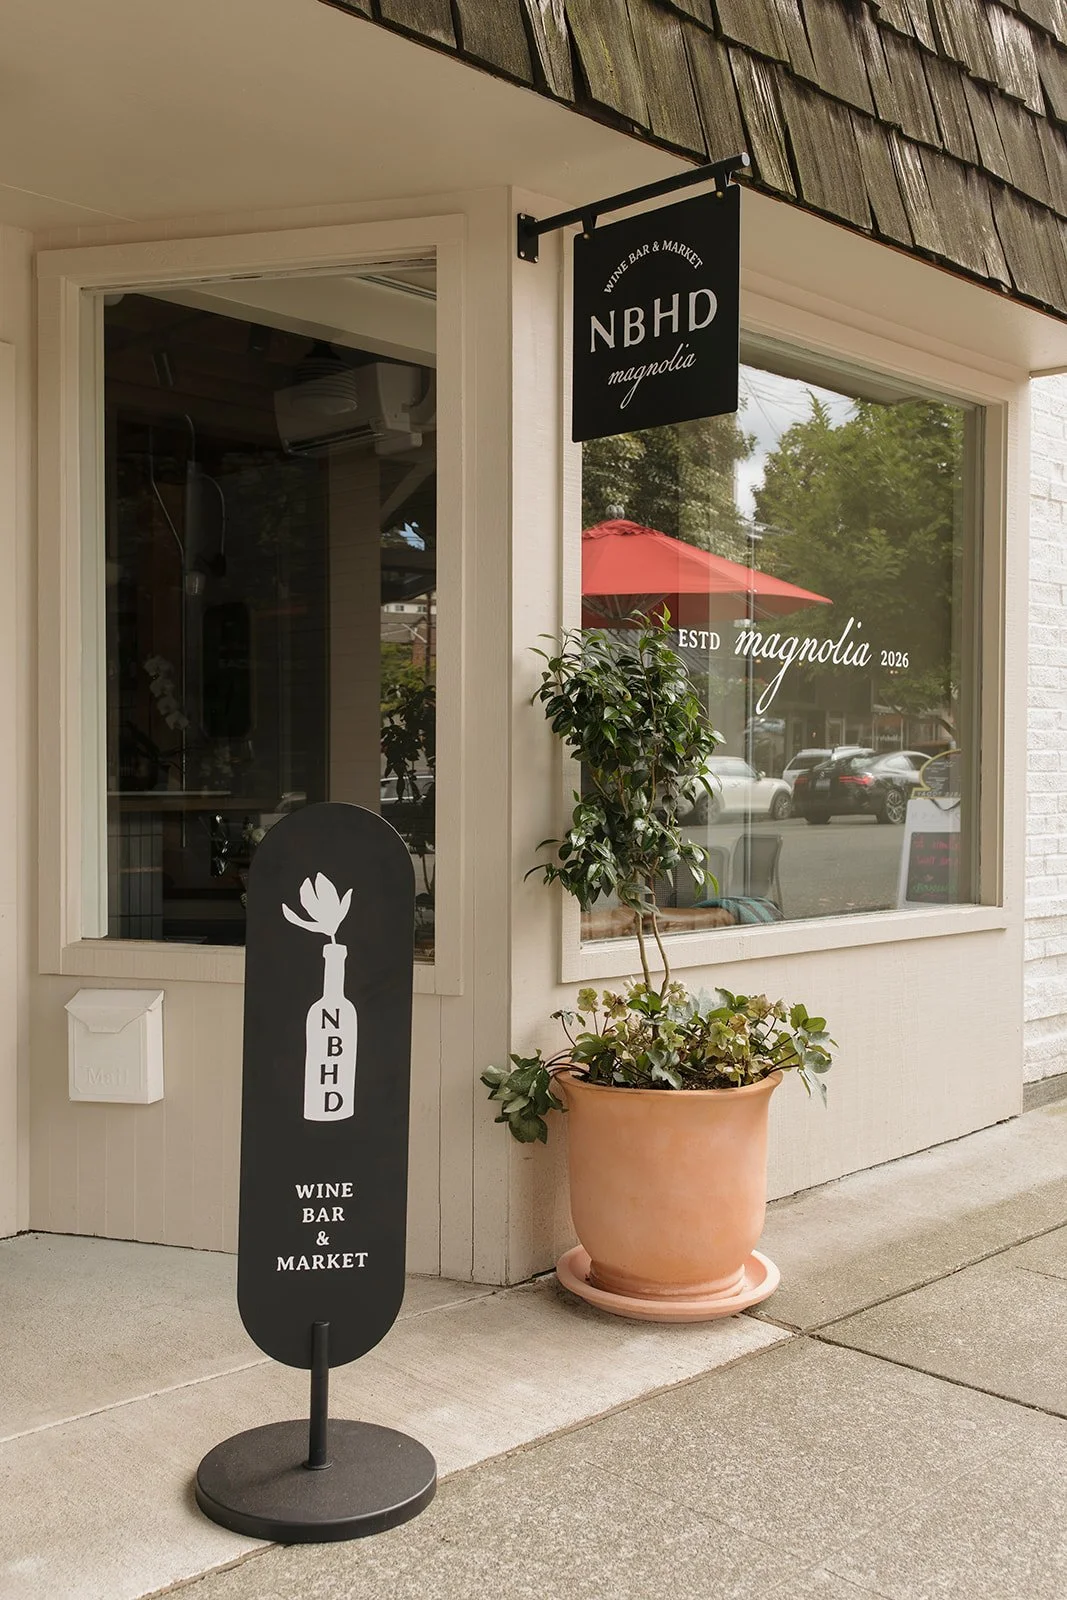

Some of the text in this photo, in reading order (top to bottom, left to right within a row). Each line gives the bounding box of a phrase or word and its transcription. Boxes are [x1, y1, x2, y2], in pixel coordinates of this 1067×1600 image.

[603, 239, 704, 293] WINE BAR & MARKET
[590, 288, 718, 353] NBHD
[607, 342, 697, 410] magnolia
[678, 616, 909, 715] ESTD magnolia 2026
[86, 1066, 129, 1088] Mail
[320, 1008, 344, 1113] NBHD
[295, 1182, 354, 1200] WINE
[301, 1206, 346, 1224] BAR
[315, 1230, 330, 1247] &
[276, 1252, 369, 1272] MARKET
